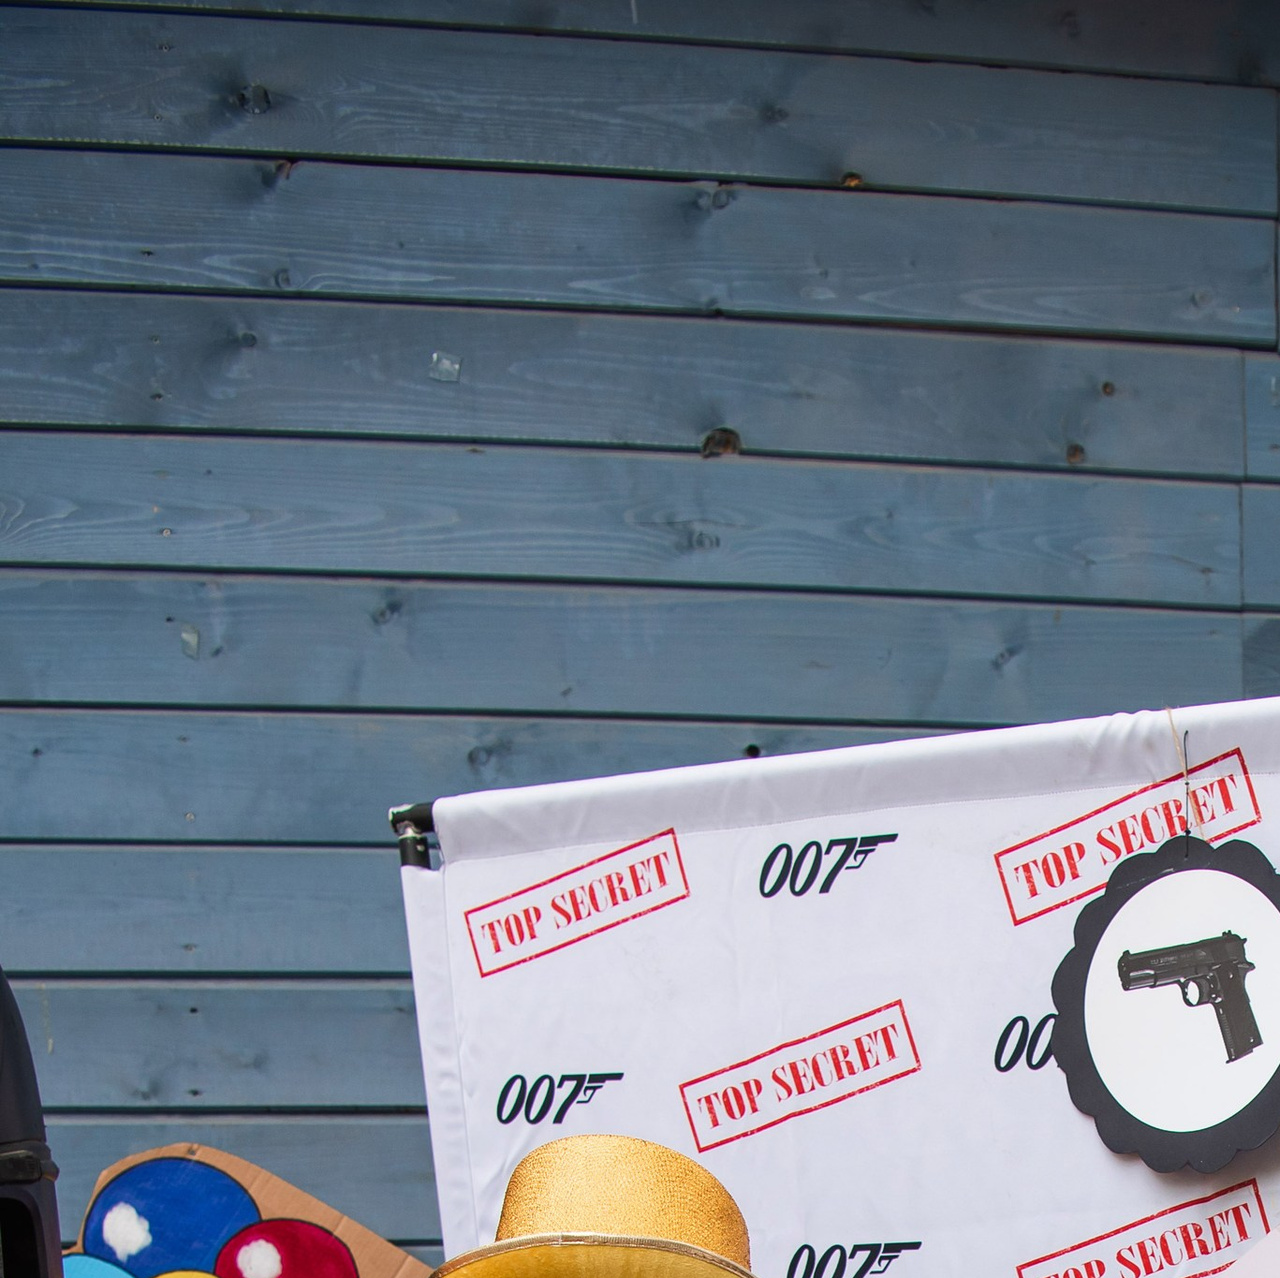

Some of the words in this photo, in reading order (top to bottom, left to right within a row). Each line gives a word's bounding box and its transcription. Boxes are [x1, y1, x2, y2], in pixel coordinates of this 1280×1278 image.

[759, 833, 898, 899] 007
[1013, 841, 1087, 899] TOP
[1095, 773, 1237, 866] SECRET
[482, 905, 543, 954] TOP
[550, 850, 670, 927] SECRET
[695, 1078, 764, 1129] TOP
[770, 1023, 898, 1100] SECRET
[994, 1014, 1058, 1074] 00
[496, 1072, 624, 1126] 007
